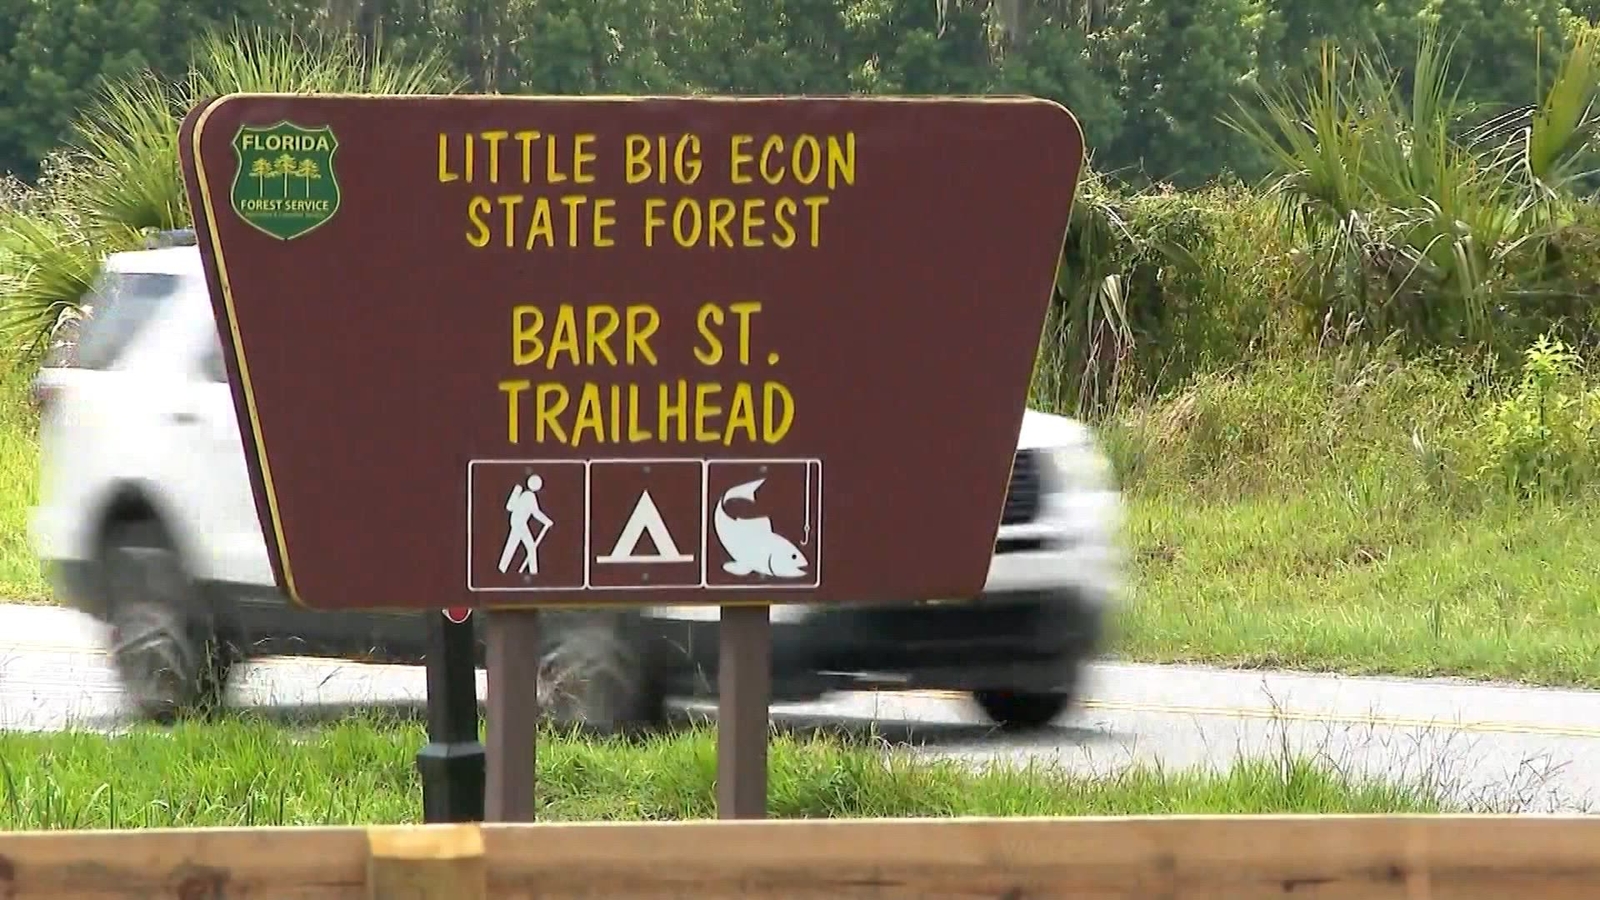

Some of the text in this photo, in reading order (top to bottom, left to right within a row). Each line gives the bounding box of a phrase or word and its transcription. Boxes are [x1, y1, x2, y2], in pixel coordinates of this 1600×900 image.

[242, 134, 330, 151] FLORIDA
[437, 130, 857, 190] LITTLE BIG ECON
[240, 199, 329, 211] FOREST SERVICE
[464, 194, 830, 251] STATE FOREST
[511, 301, 780, 369] BARR ST.
[497, 379, 796, 448] TRAILHEAD
